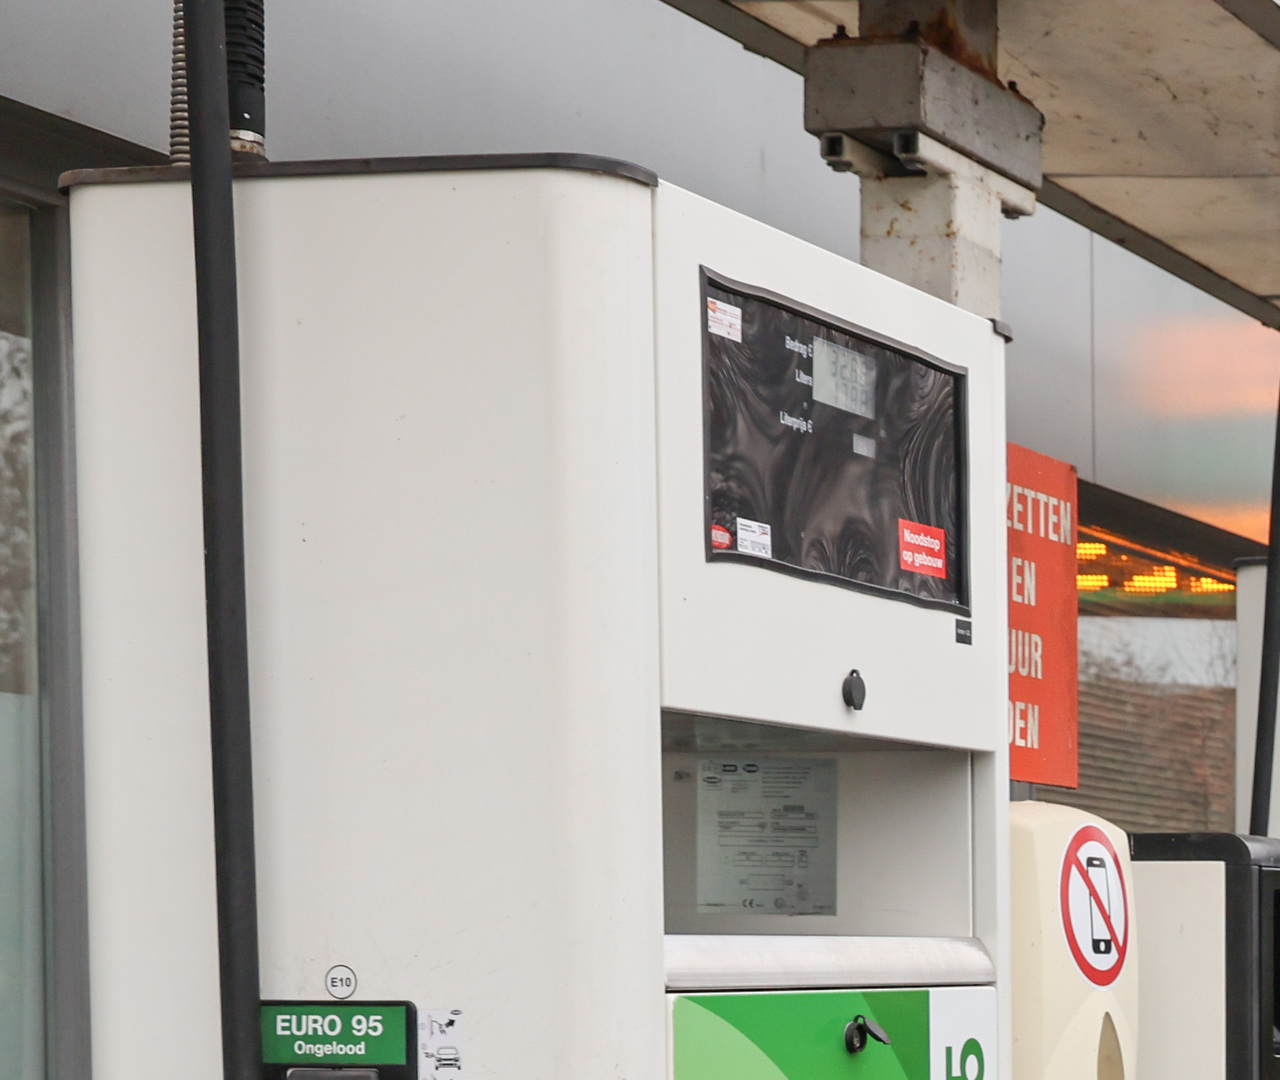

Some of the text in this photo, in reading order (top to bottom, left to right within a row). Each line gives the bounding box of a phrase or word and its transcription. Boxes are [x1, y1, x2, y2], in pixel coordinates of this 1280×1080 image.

[1006, 482, 1072, 545] ETTEN
[903, 528, 941, 552] Noodstop
[902, 550, 944, 568] op gebouw
[1008, 628, 1043, 680] UUR
[330, 977, 352, 988] E10
[276, 1014, 384, 1036] EURO 95
[294, 1040, 366, 1058] Ongelood
